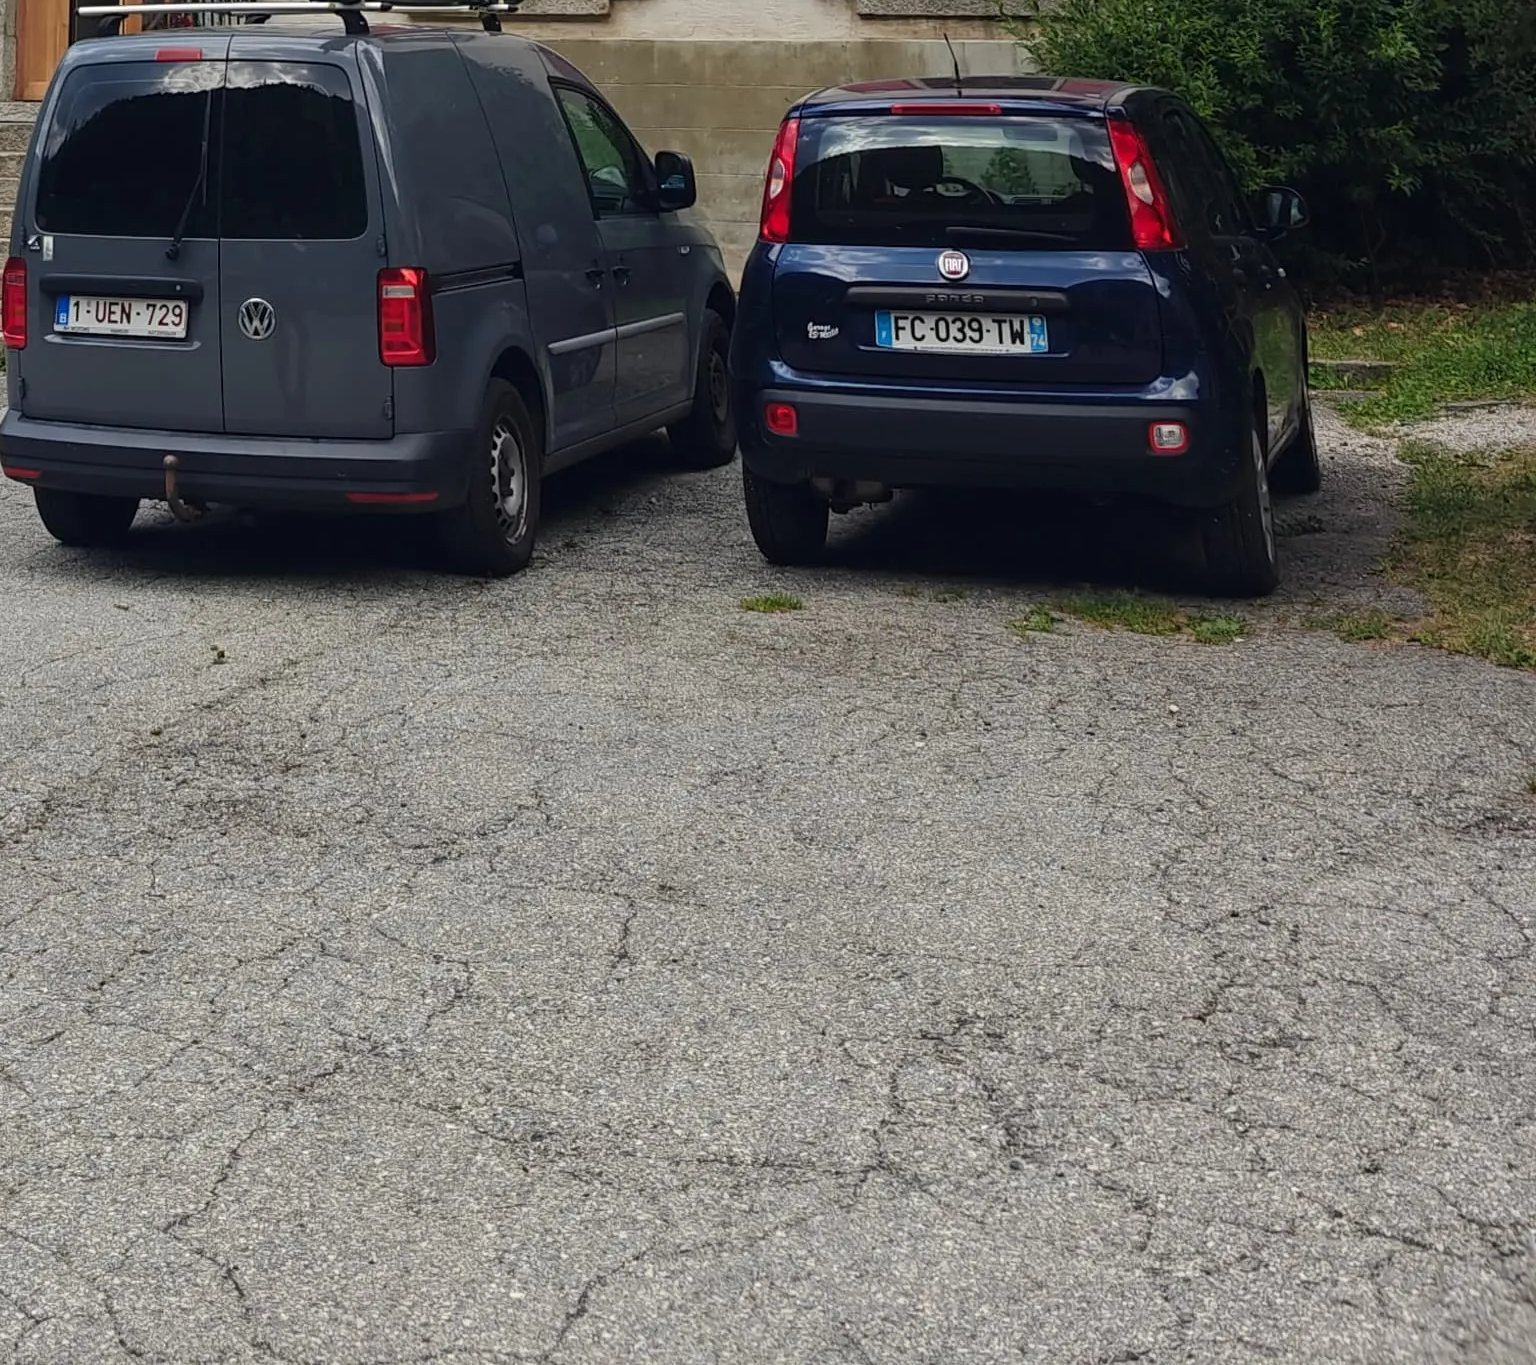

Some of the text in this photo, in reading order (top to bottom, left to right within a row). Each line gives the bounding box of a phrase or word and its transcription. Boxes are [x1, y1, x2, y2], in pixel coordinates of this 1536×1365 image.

[944, 257, 963, 272] FIAT
[59, 312, 67, 324] B
[893, 315, 1026, 346] FC-039-TW
[1030, 332, 1046, 346] 74
